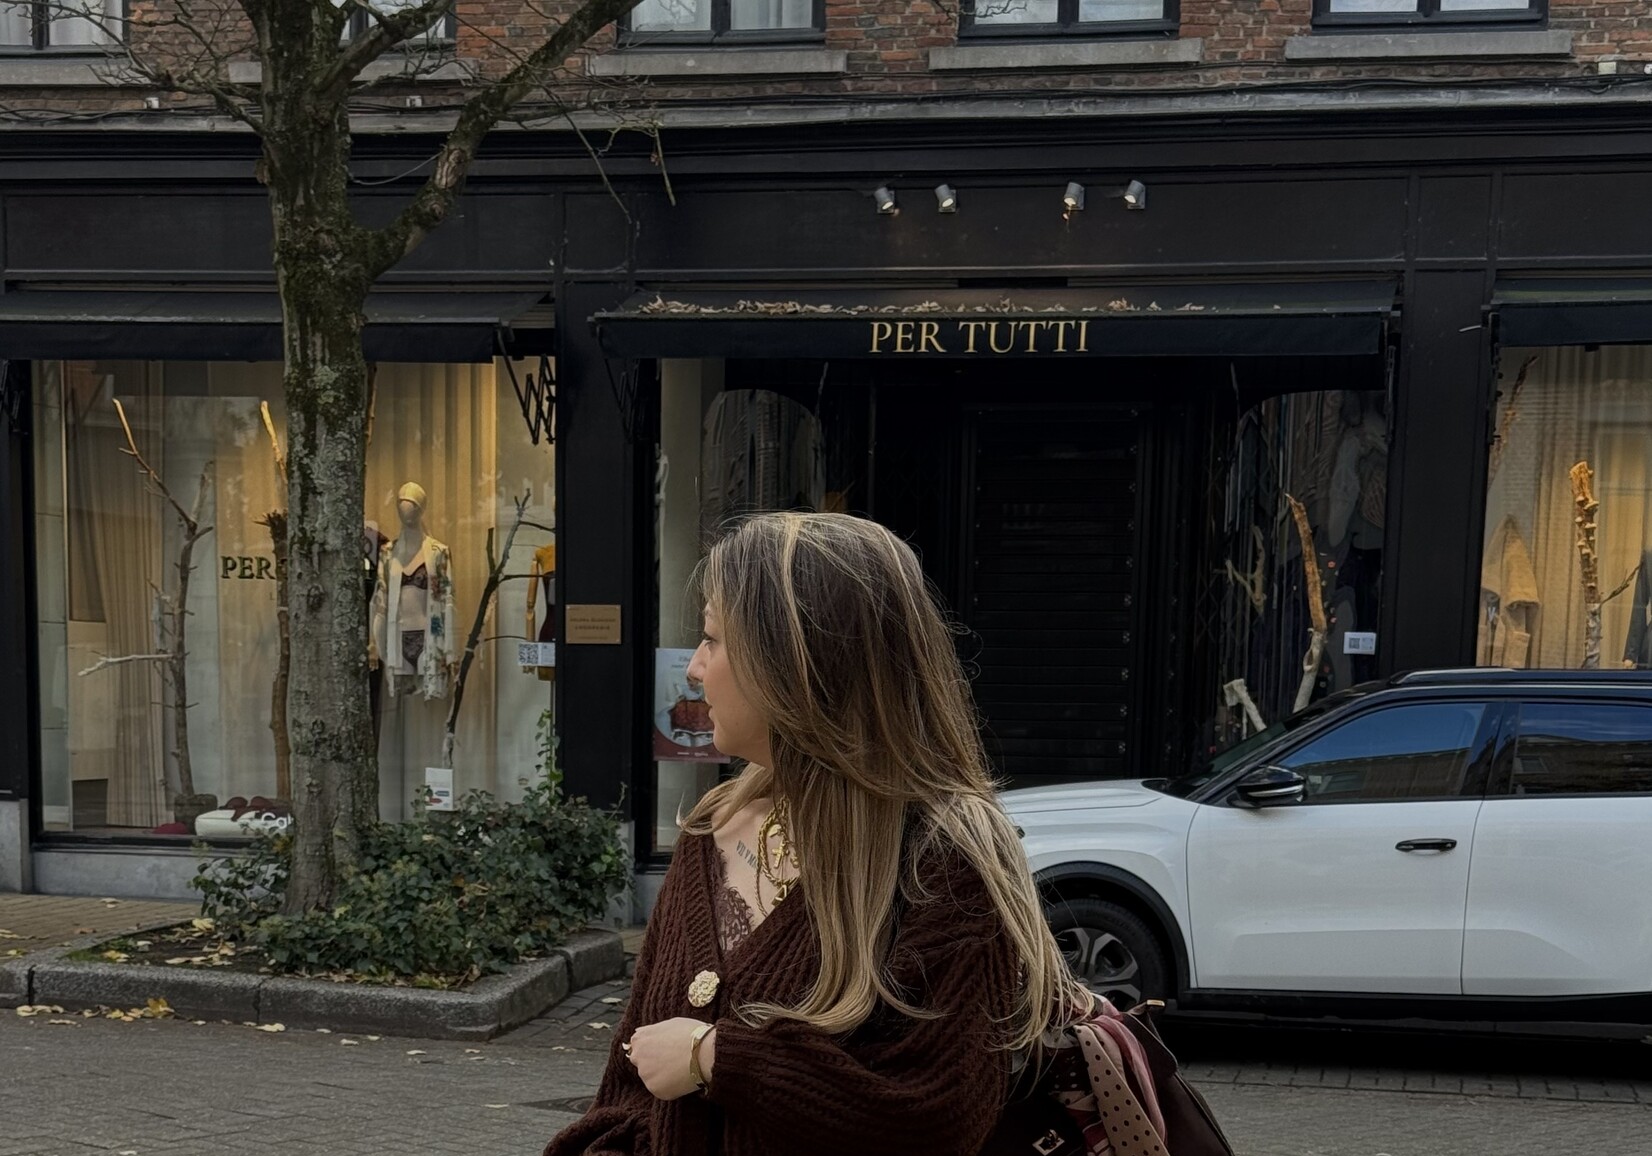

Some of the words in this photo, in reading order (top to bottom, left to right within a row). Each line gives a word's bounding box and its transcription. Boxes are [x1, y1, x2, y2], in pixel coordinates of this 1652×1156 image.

[869, 321, 947, 353] PER
[958, 320, 1090, 353] TUTTI
[220, 556, 276, 579] PER
